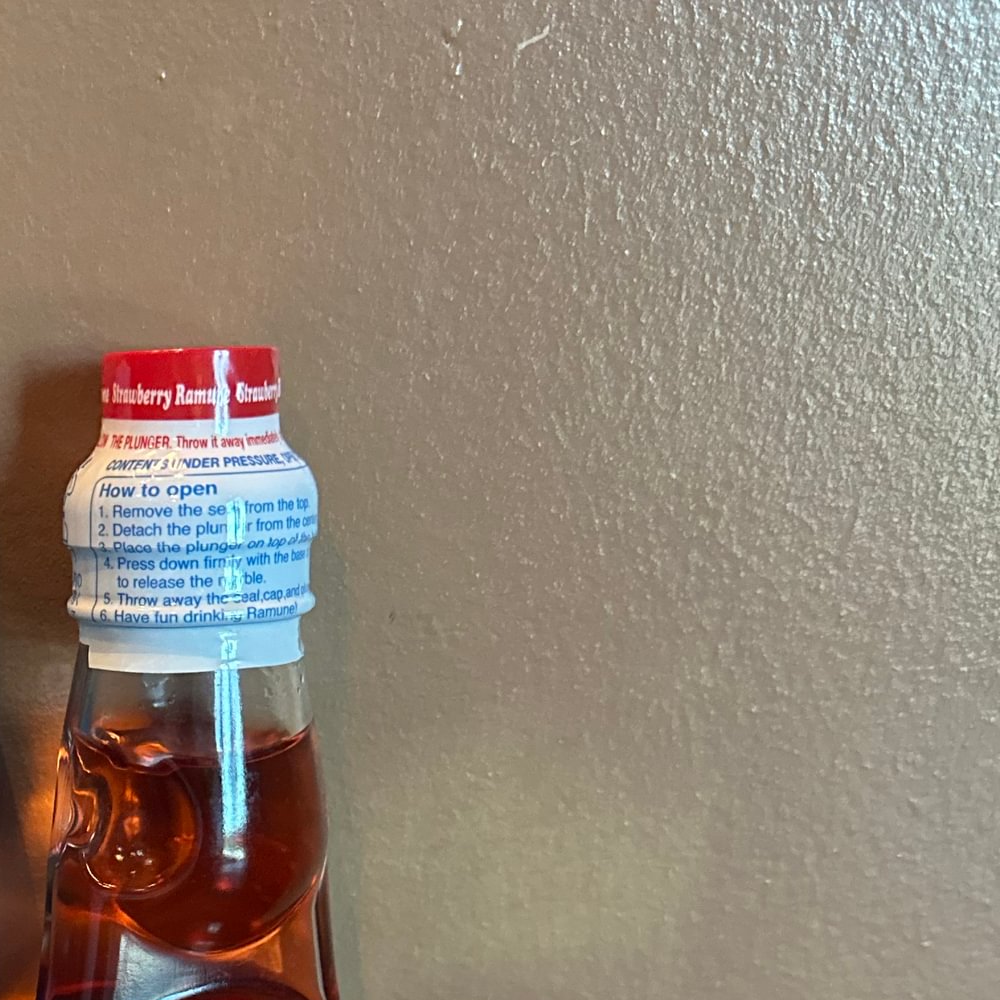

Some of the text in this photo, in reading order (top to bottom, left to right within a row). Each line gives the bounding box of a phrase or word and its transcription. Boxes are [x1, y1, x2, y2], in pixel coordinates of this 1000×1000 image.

[112, 382, 172, 411] Strawberry
[176, 435, 208, 449] Throw
[211, 434, 218, 448] it
[221, 437, 245, 451] away
[99, 483, 217, 500] How to open
[98, 506, 109, 519] 1.
[112, 504, 173, 519] Remove
[178, 503, 202, 517] the
[245, 501, 274, 514] from
[278, 498, 294, 512] the
[97, 523, 109, 537] 2.
[113, 523, 162, 537] Detach
[167, 522, 191, 537] the
[195, 521, 253, 538] plunr
[256, 518, 284, 532] from
[286, 515, 300, 529] the
[113, 541, 153, 554] Place
[157, 541, 180, 554] the
[247, 541, 264, 549] on
[267, 536, 287, 549] top
[103, 558, 114, 570] 4.
[117, 557, 155, 571] Press
[159, 557, 199, 571] down
[246, 552, 271, 566] with
[273, 550, 289, 564] the
[117, 576, 129, 588] to
[133, 576, 185, 588] release
[190, 575, 213, 588] the
[103, 592, 114, 605] 5.
[117, 593, 158, 606] Throw
[162, 595, 202, 608] away
[207, 592, 230, 605] the
[115, 610, 150, 622] Have
[155, 610, 178, 622] fun
